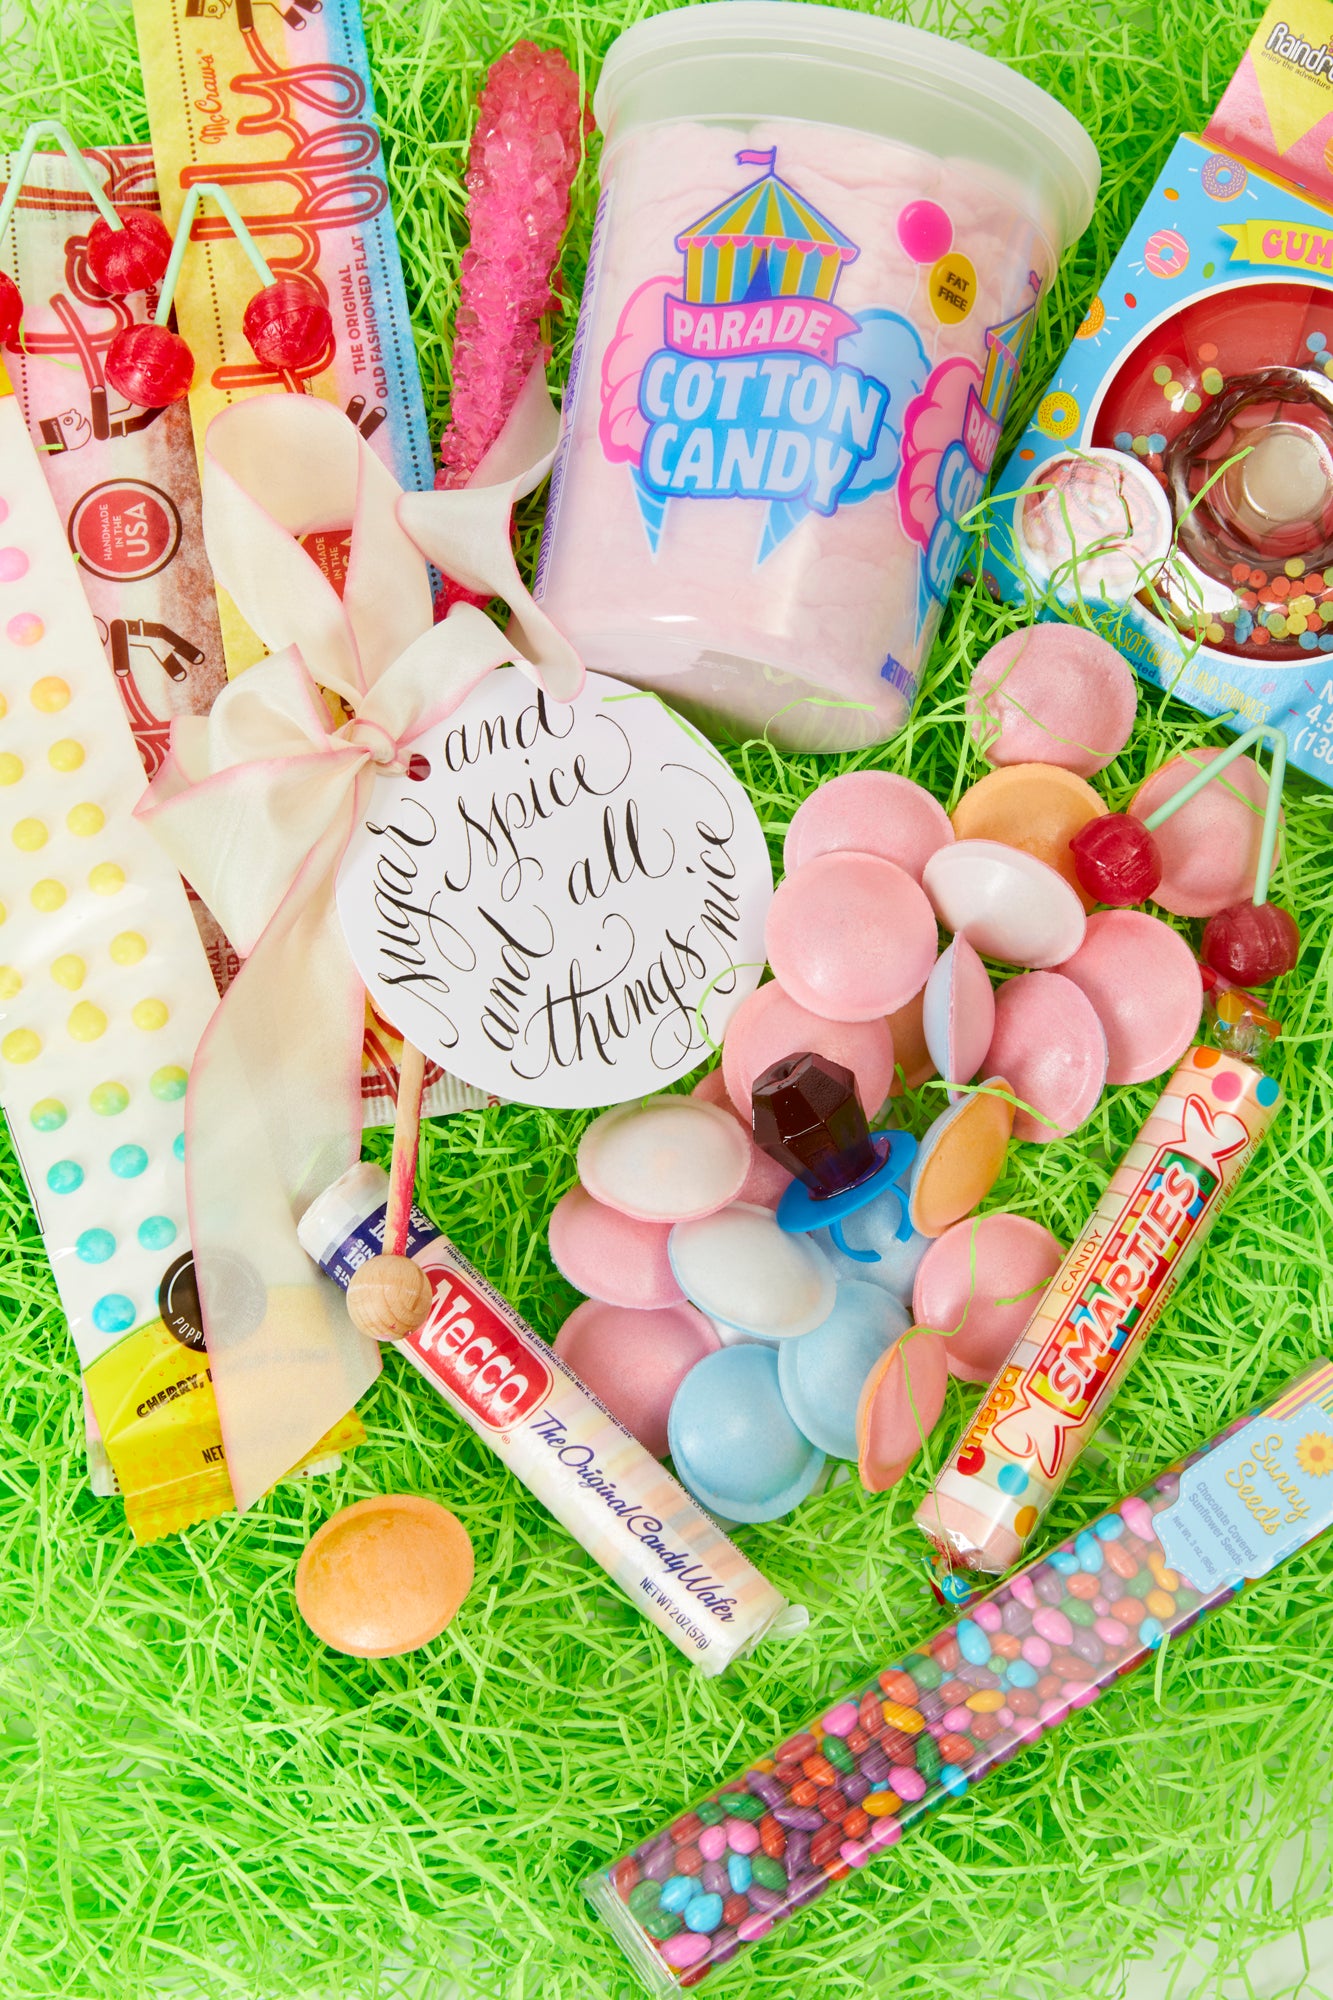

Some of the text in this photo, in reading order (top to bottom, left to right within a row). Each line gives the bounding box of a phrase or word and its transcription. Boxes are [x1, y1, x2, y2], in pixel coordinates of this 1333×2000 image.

[1261, 50, 1331, 91] enjoy the adventure
[351, 235, 389, 399] OLD FASHIONED FLAT
[937, 285, 968, 312] FREE
[946, 270, 970, 292] FAT
[338, 264, 366, 375] THE ORIGINAL
[672, 303, 833, 350] PARADE
[644, 356, 884, 449] COTTON
[645, 422, 857, 503] CANDY
[99, 503, 112, 561] HANDMADE
[113, 515, 124, 548] IN THE
[124, 501, 150, 557] USA
[330, 547, 342, 580] IN THE
[1119, 628, 1151, 658] SOFT
[1191, 669, 1219, 697] AND
[443, 714, 633, 903] spice
[366, 797, 477, 1049] sugar
[444, 687, 576, 772] and
[480, 904, 555, 1052] and
[567, 798, 677, 906] all
[509, 763, 741, 1081] things nice
[1214, 1197, 1226, 1215] NET
[1223, 1183, 1234, 1198] WT
[355, 1238, 376, 1260] SIN
[1050, 1163, 1198, 1404] SMARTIES
[1061, 1228, 1103, 1293] CANDY
[418, 1278, 529, 1412] Necco
[443, 1245, 477, 1281] PROCESSED
[475, 1279, 484, 1287] IN
[487, 1290, 514, 1317] FACILITY
[513, 1315, 528, 1333] THAT
[526, 1330, 544, 1349] ALSO
[541, 1346, 576, 1382] PROCESSES
[574, 1381, 590, 1400] MILK,
[591, 1397, 608, 1415] EGGS
[606, 1413, 622, 1427] AND
[1141, 1276, 1178, 1341] original
[136, 1372, 205, 1419] CHERRY,
[958, 1365, 1024, 1460] mega
[202, 1445, 224, 1464] NET
[1251, 1433, 1311, 1524] Sunny
[530, 1409, 568, 1448] The
[557, 1445, 642, 1519] Original
[626, 1514, 688, 1573] Candy
[677, 1564, 738, 1623] Wafer
[1172, 1515, 1184, 1530] Net
[1181, 1528, 1192, 1543] Wt.
[1188, 1492, 1244, 1566] Sunflower Seeds
[1196, 1481, 1258, 1562] Chocolate Covered
[1225, 1460, 1282, 1536] Seeds
[640, 1576, 712, 1651] NET WT 2 OZ (57g)
